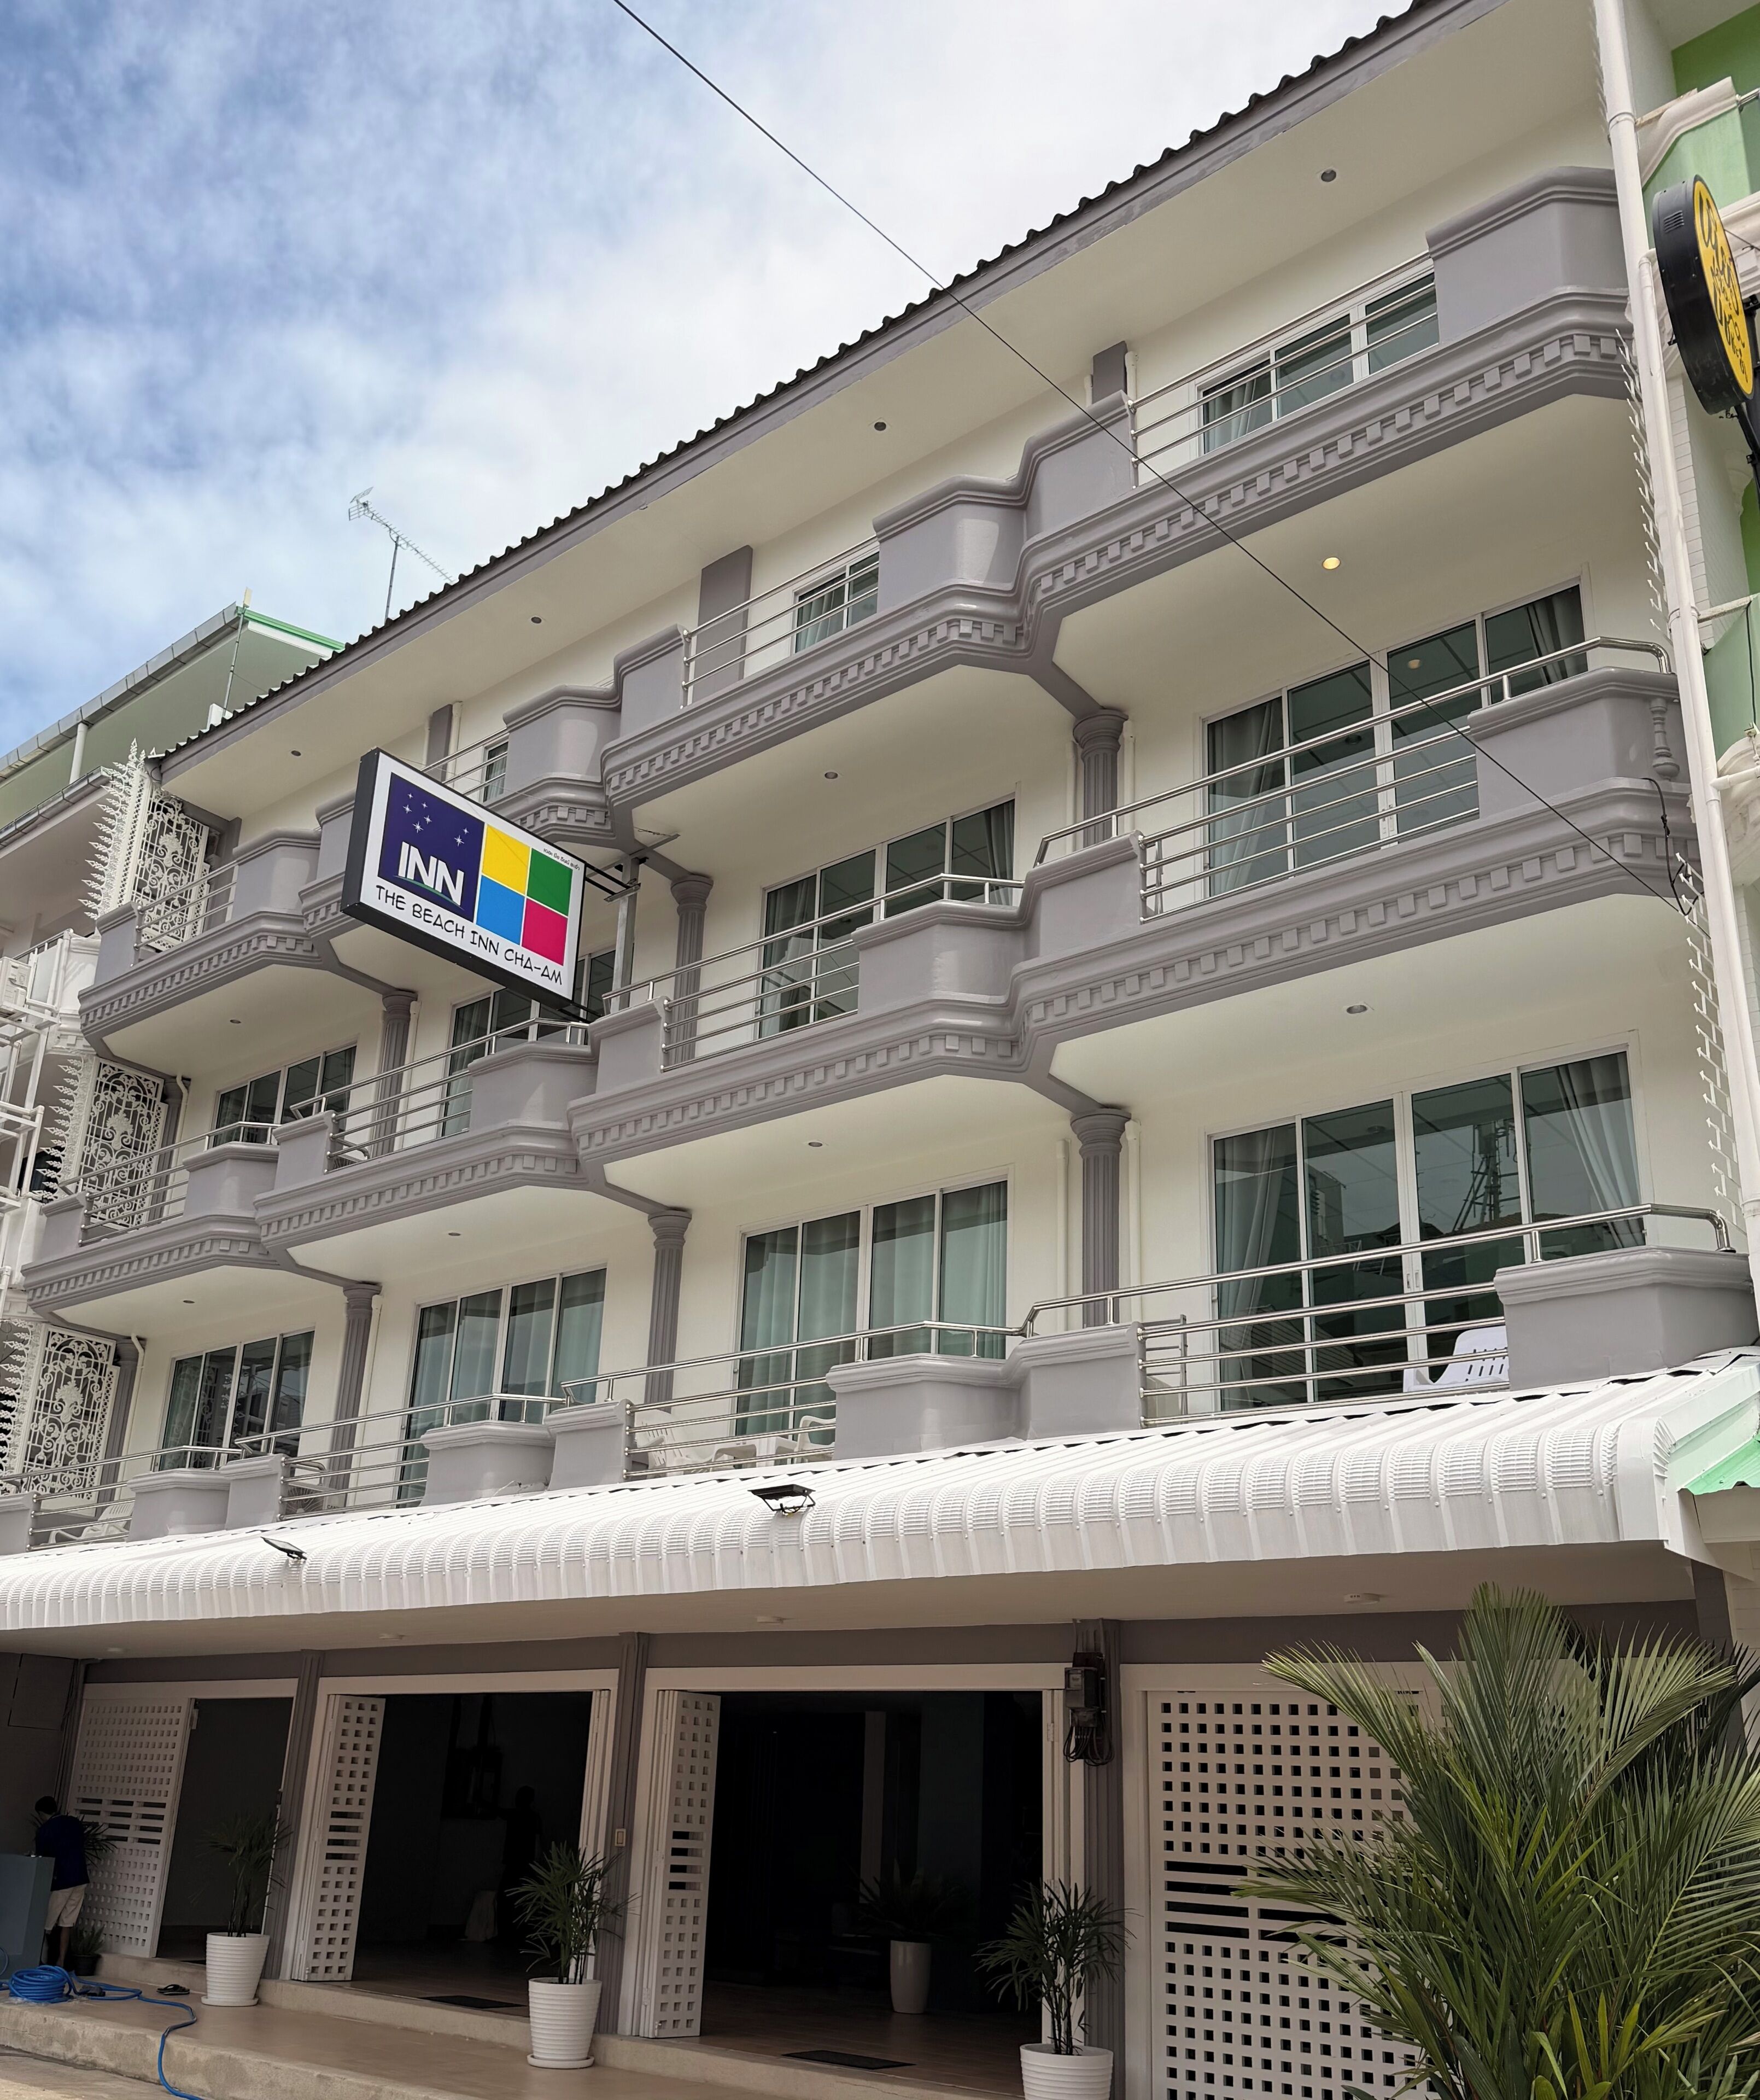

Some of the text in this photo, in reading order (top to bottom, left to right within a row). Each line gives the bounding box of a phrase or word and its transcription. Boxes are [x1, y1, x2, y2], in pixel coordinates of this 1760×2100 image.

[398, 841, 465, 906] INN
[376, 885, 562, 985] THE BEACH INN CHA-AM
